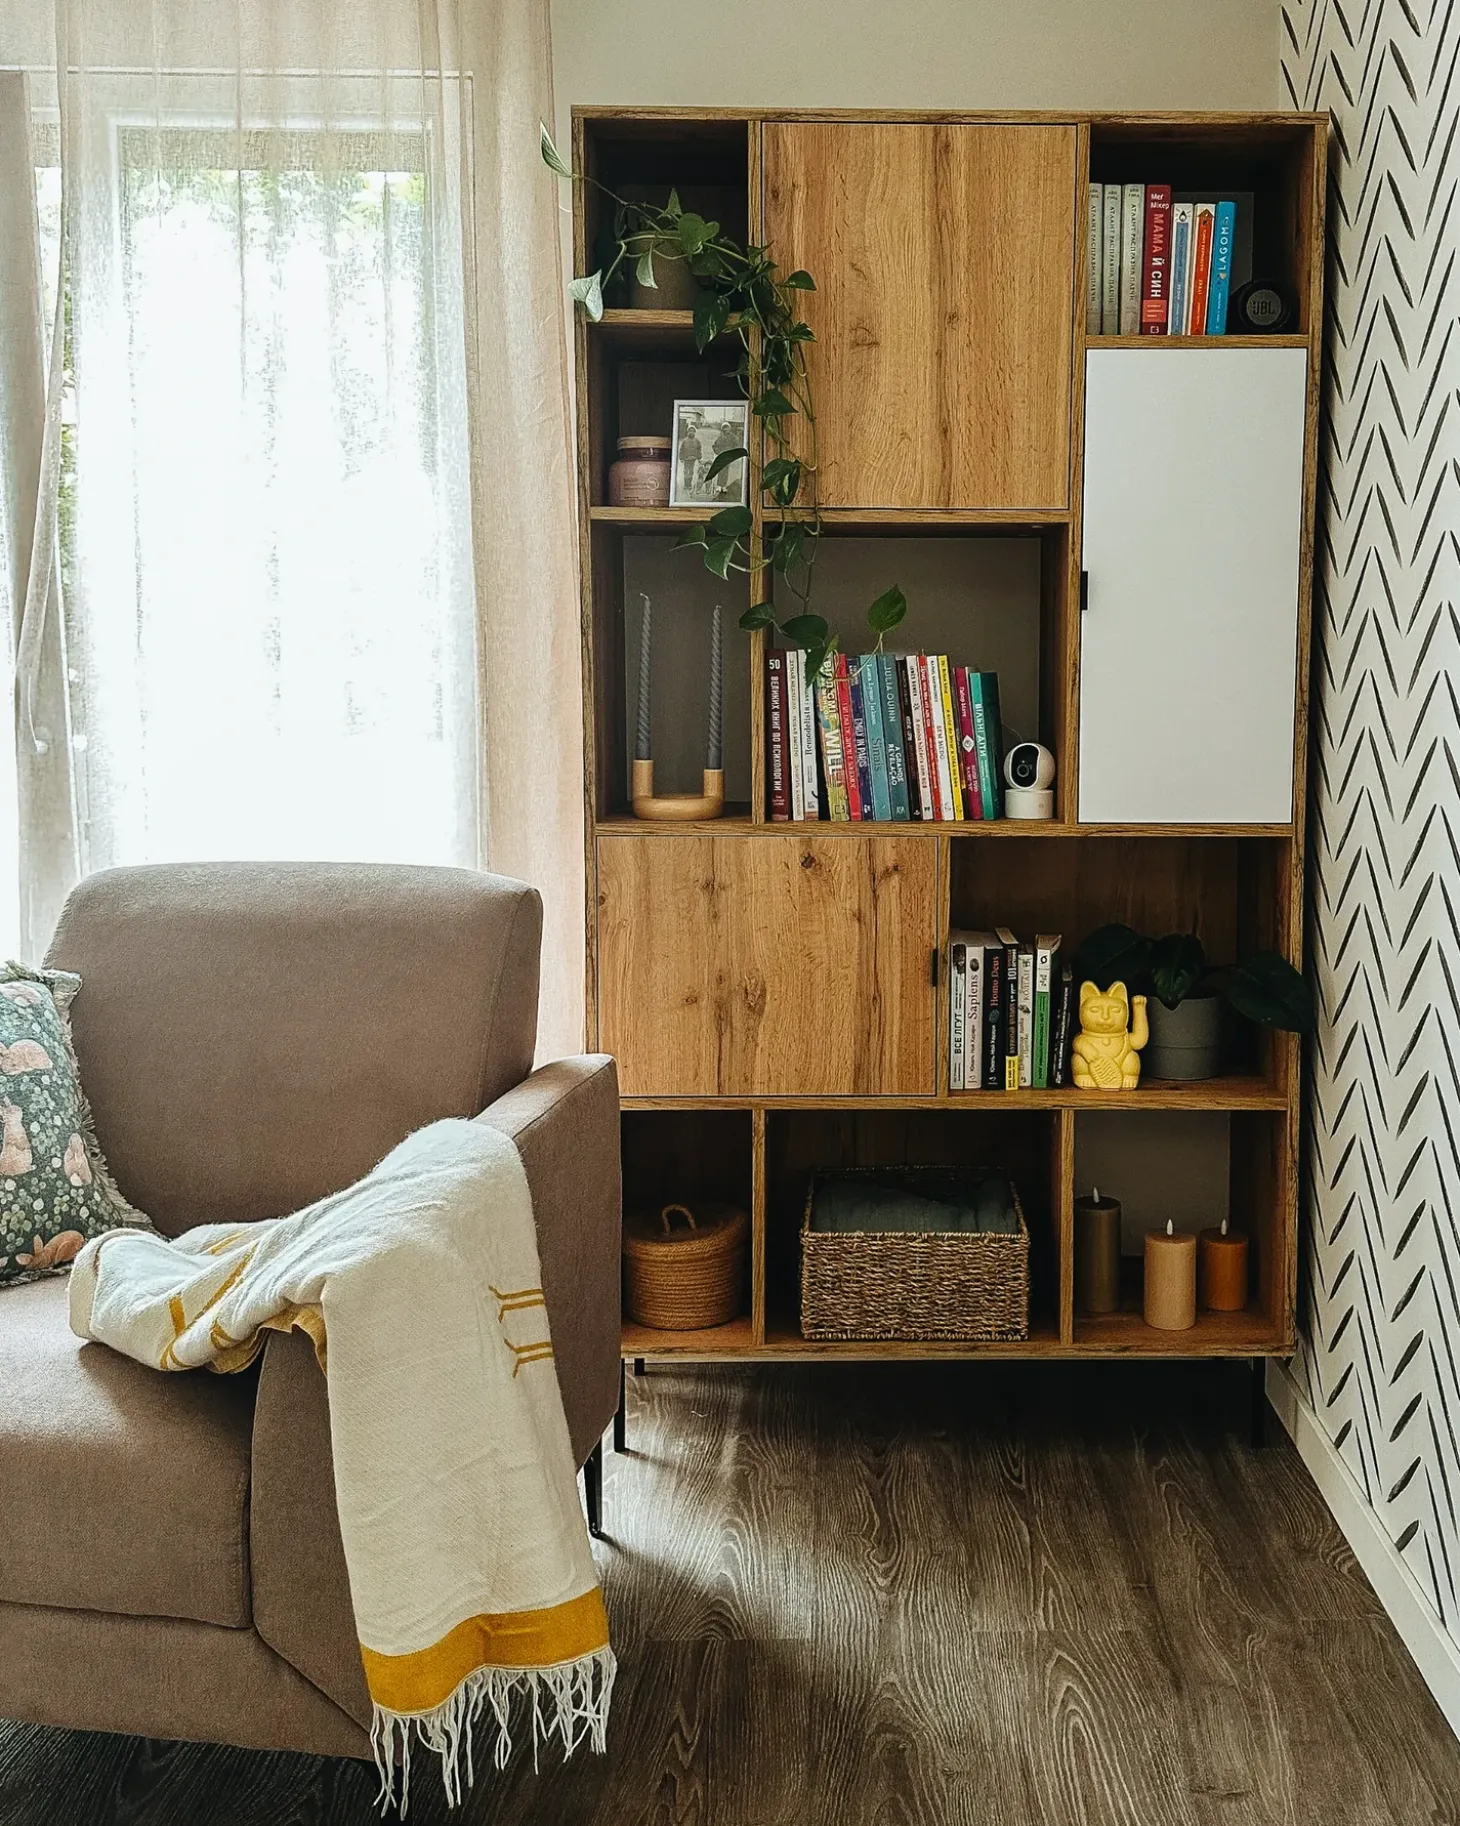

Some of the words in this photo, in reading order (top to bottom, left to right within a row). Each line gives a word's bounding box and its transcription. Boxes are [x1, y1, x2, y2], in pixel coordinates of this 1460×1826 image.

[1152, 213, 1164, 253] МАМА
[1218, 226, 1229, 270] LAGOM
[1152, 257, 1165, 266] Й
[1151, 271, 1162, 298] СИН
[1252, 300, 1275, 315] JBL
[768, 659, 781, 670] 50
[884, 666, 893, 691] JULIA
[771, 675, 780, 710] ВЕЛИКИХ
[887, 693, 896, 722] QUINN
[975, 703, 984, 732] ВІЛЬНІ
[771, 711, 781, 731] КНИГ
[854, 718, 864, 737] EMILY
[772, 732, 781, 743] ПО
[976, 734, 987, 757] ДІТИ
[824, 729, 843, 774] WILL
[857, 747, 867, 768] PARIS
[871, 738, 883, 773] Sinais
[772, 744, 782, 791] ПСИХОЛОГИИ
[887, 743, 897, 786] REVELAÇÃO
[896, 752, 904, 782] GRANDE
[991, 956, 1000, 977] Deus
[1007, 967, 1017, 980] 101
[968, 974, 980, 1020] Sapiens
[990, 980, 999, 1006] Homo
[954, 1012, 962, 1035] ЛГУТ
[954, 1037, 962, 1054] ВСЕ
